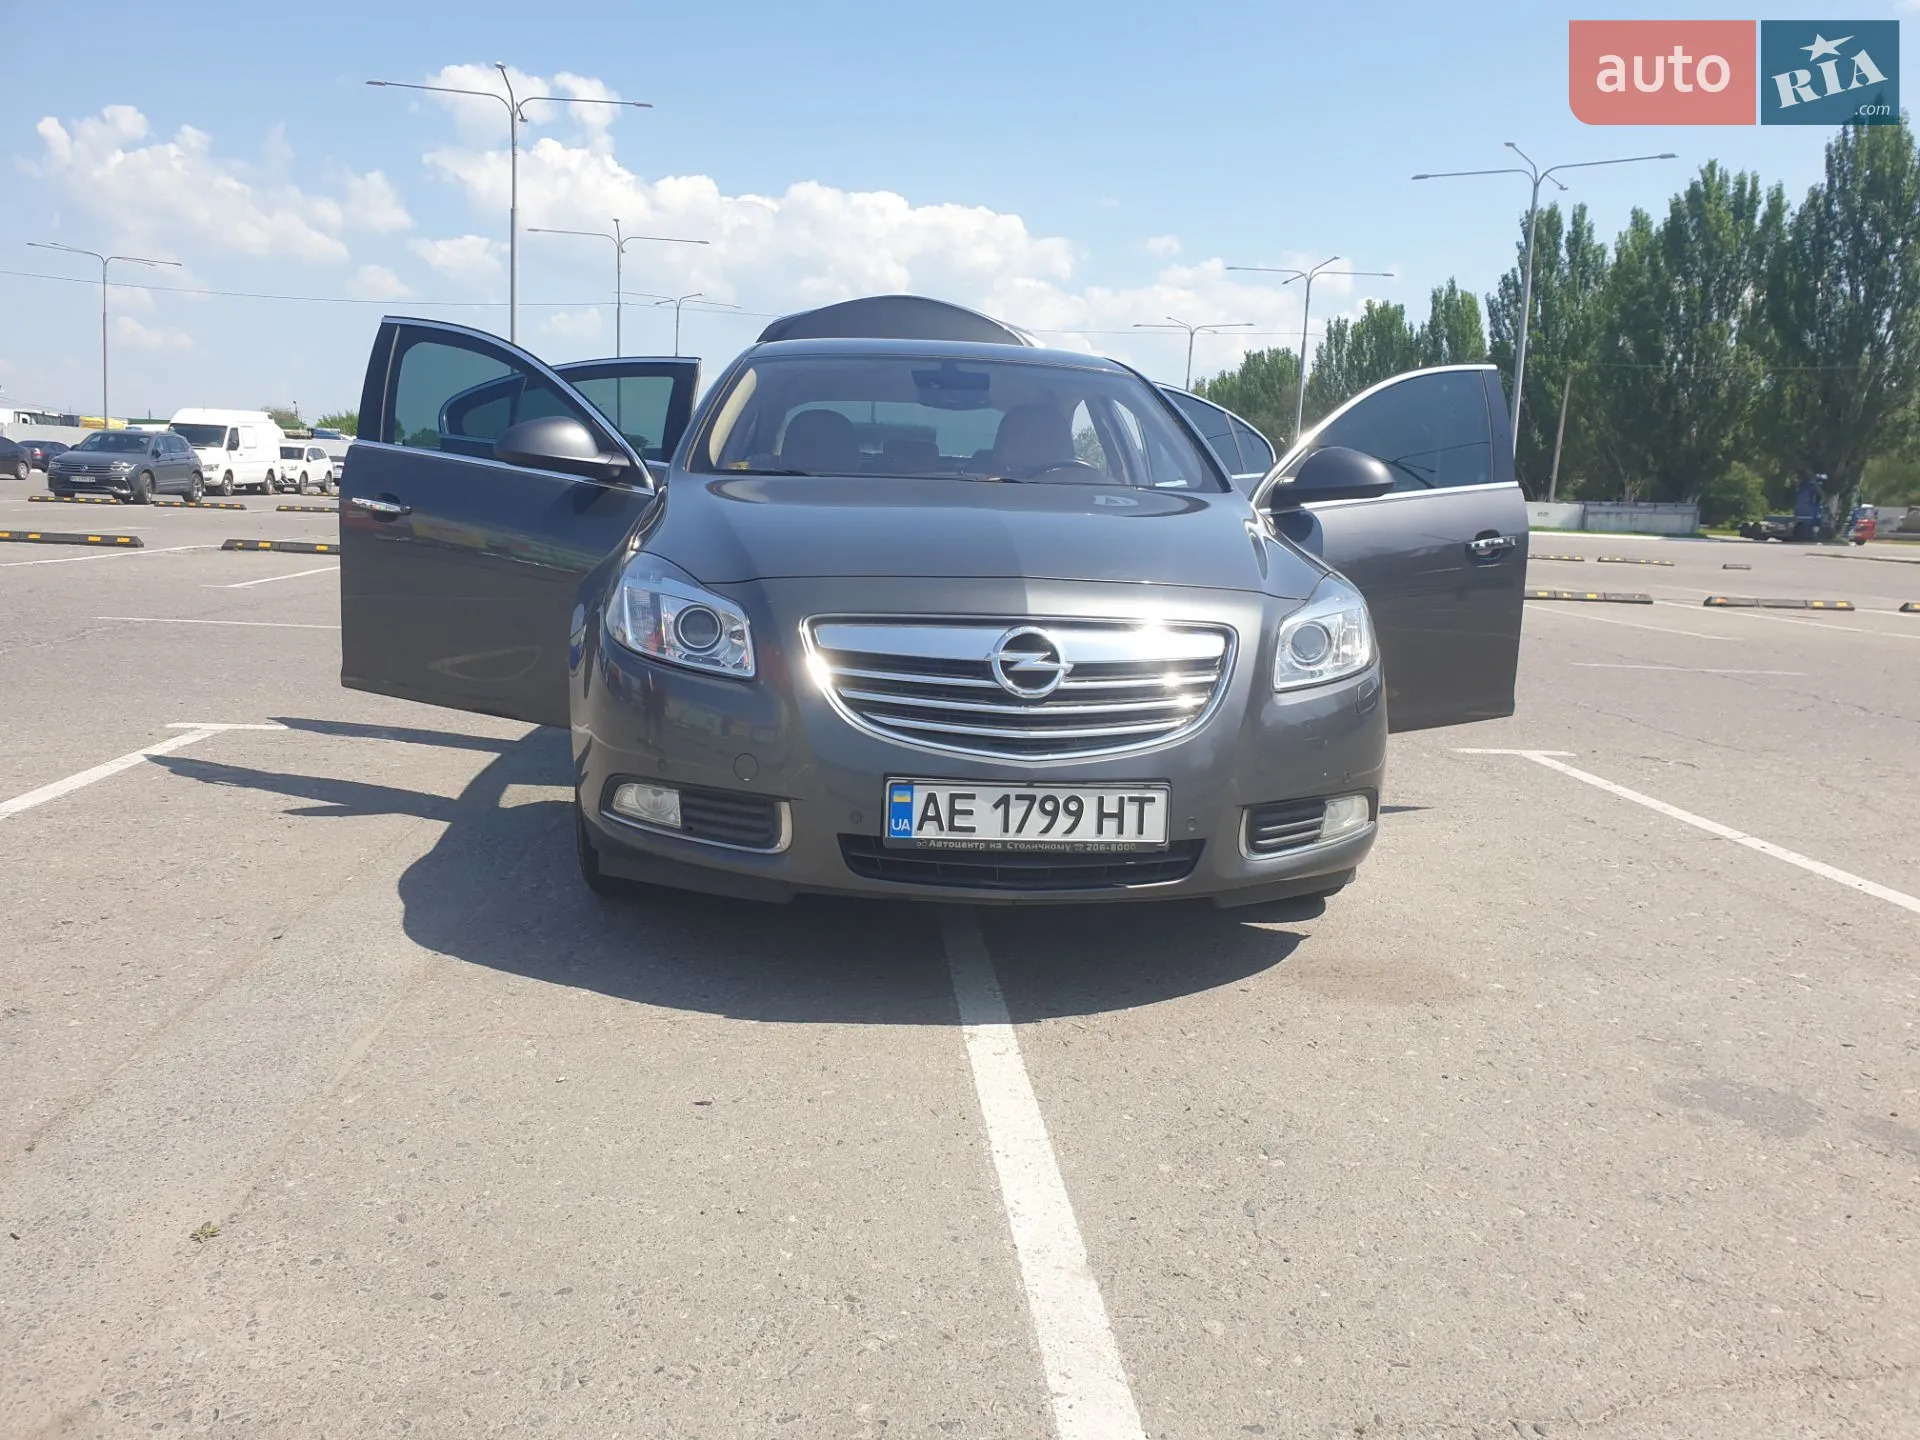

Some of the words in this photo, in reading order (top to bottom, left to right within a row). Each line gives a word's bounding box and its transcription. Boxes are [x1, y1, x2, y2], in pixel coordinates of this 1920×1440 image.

[917, 792, 976, 833] AE
[992, 793, 1084, 835] 1799
[1097, 795, 1156, 835] HT
[891, 818, 911, 831] UA
[928, 839, 986, 850] Автоцентр
